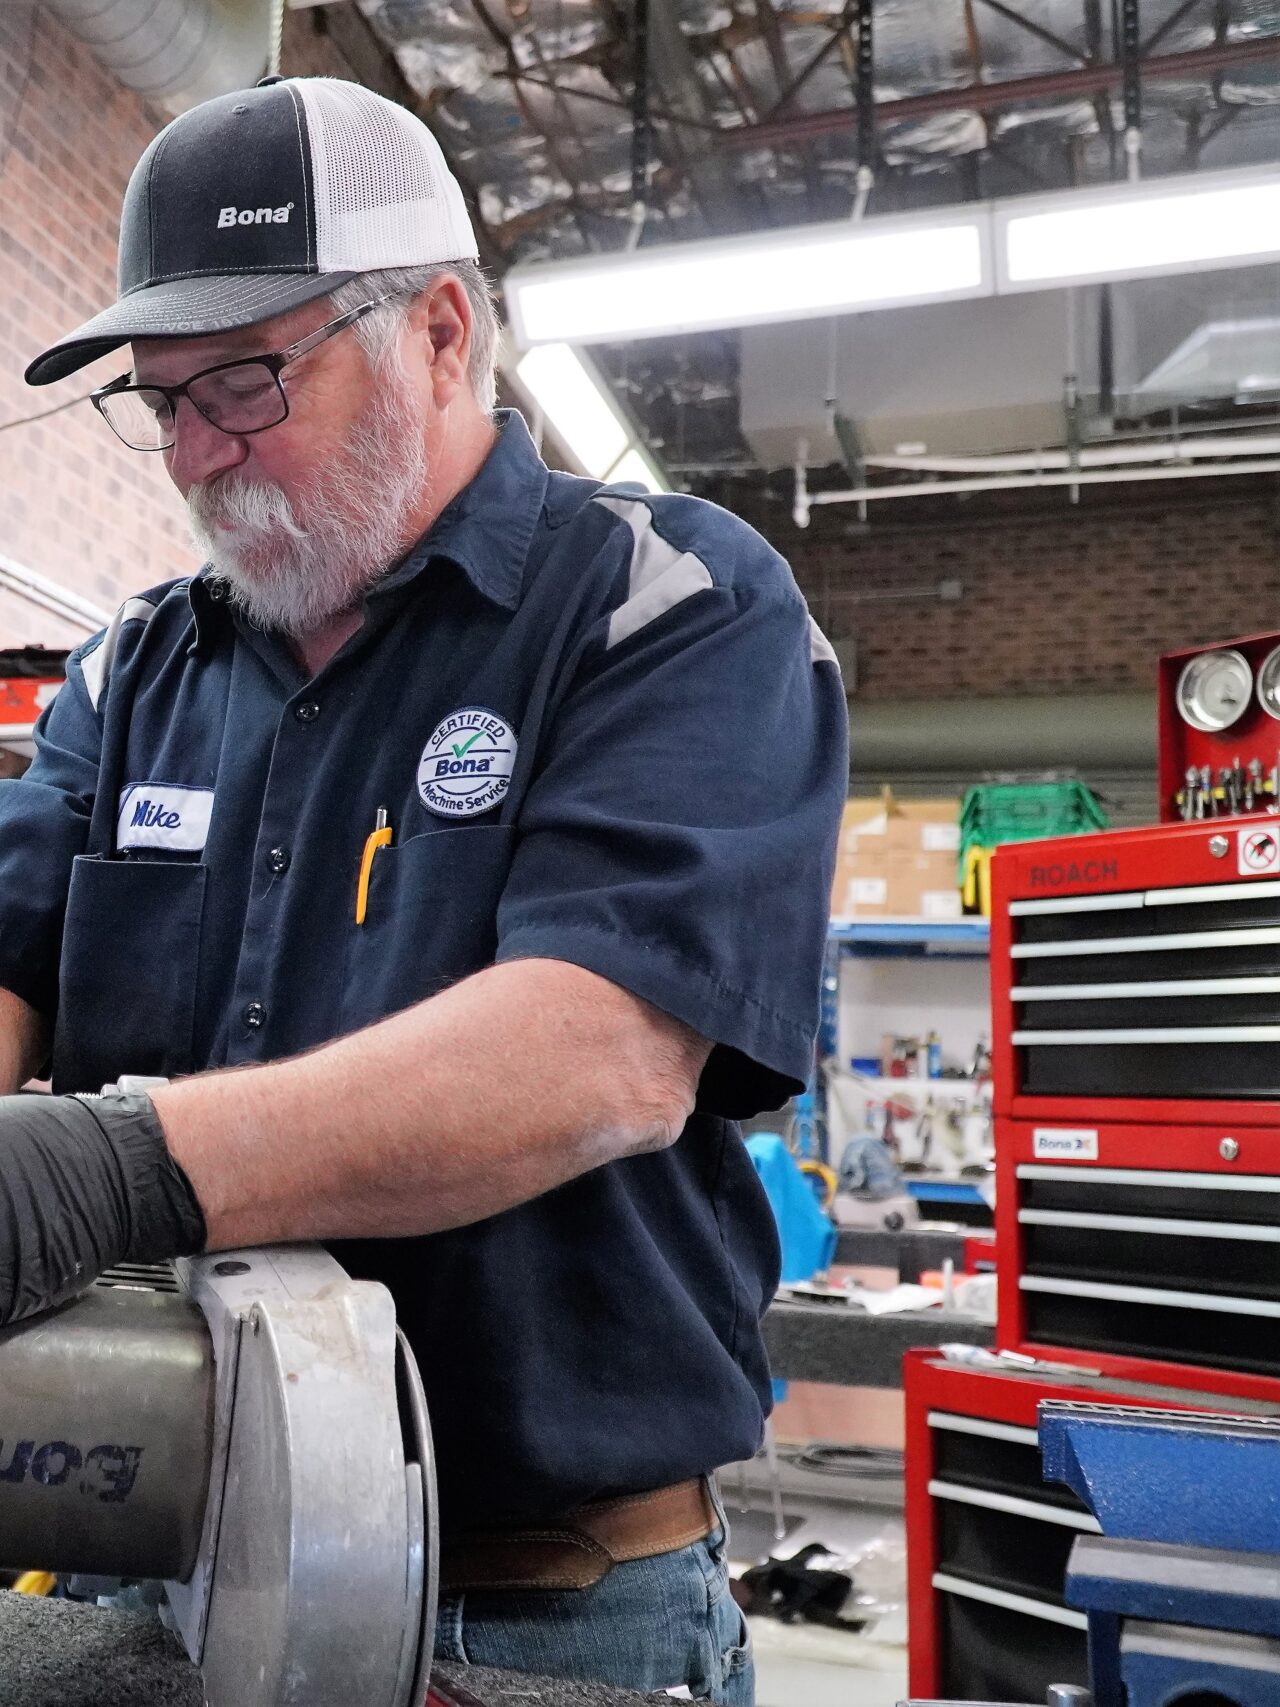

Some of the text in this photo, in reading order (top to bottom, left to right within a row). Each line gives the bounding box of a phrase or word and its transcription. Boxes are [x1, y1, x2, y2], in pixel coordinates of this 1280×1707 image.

[431, 714, 506, 746] CERTIFIED
[423, 778, 510, 811] Machine Service
[130, 800, 181, 829] Mike
[1029, 859, 1118, 886] ROACH
